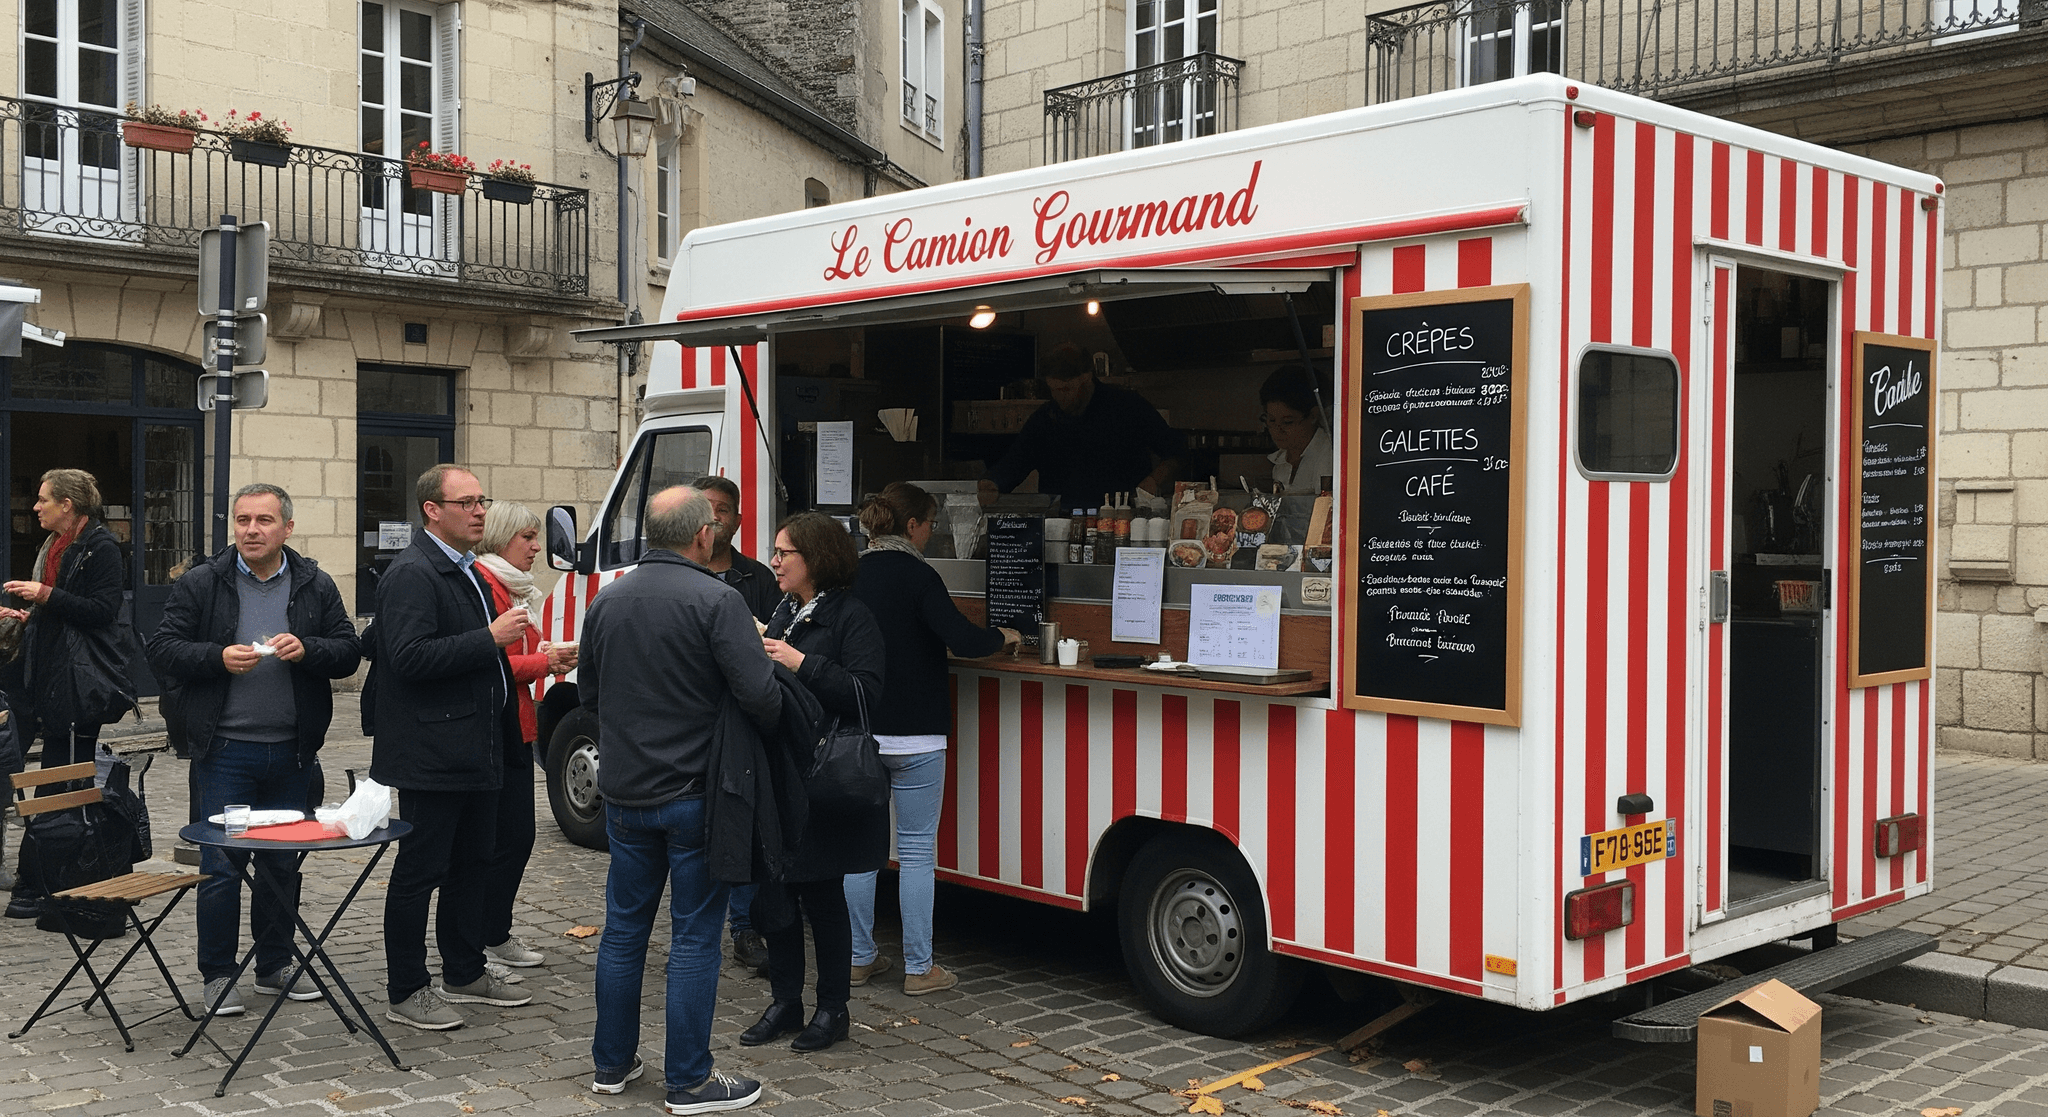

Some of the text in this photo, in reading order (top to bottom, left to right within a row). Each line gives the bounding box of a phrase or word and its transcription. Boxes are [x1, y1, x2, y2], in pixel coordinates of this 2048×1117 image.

[824, 160, 1263, 281] Le Camion Gourmand
[1379, 428, 1479, 455] GALETTES
[1405, 465, 1455, 497] CAFÉ
